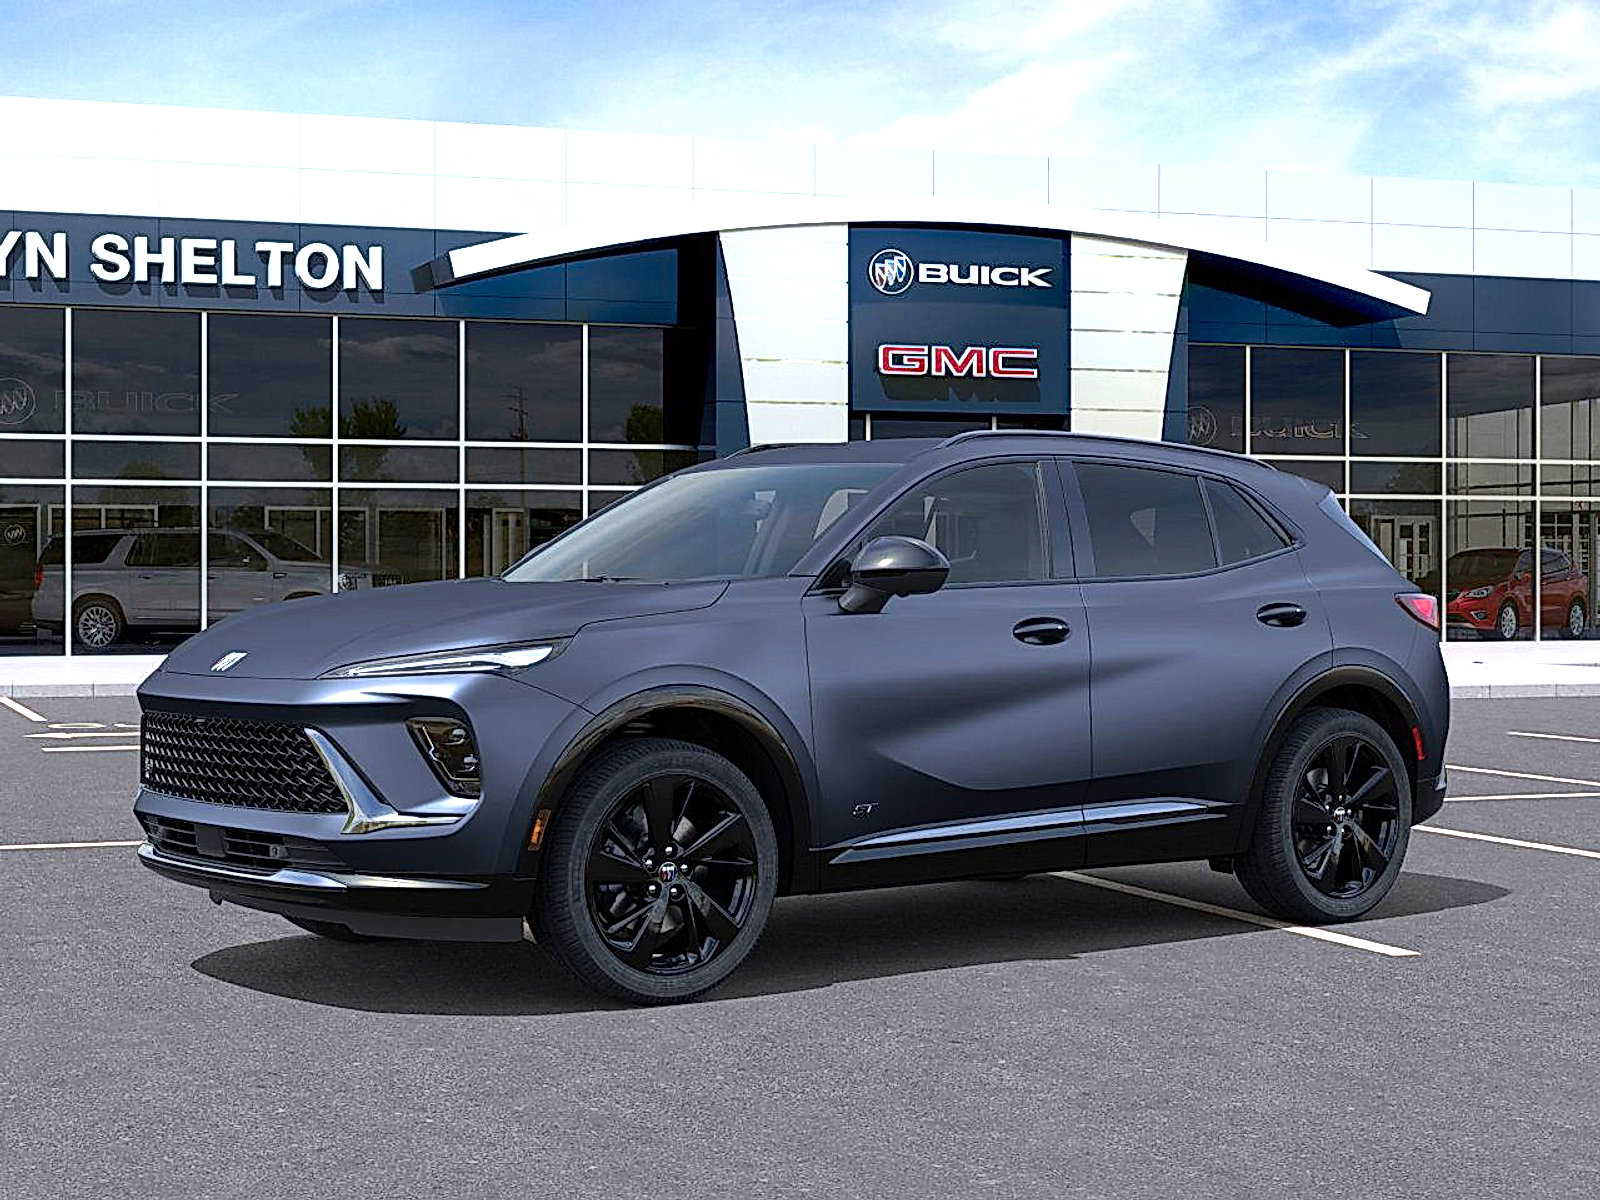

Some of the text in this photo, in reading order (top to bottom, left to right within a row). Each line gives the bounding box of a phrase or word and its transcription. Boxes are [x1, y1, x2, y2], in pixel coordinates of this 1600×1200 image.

[90, 233, 383, 290] SHELTON
[918, 263, 1053, 287] BUICK
[878, 344, 1038, 378] GMC
